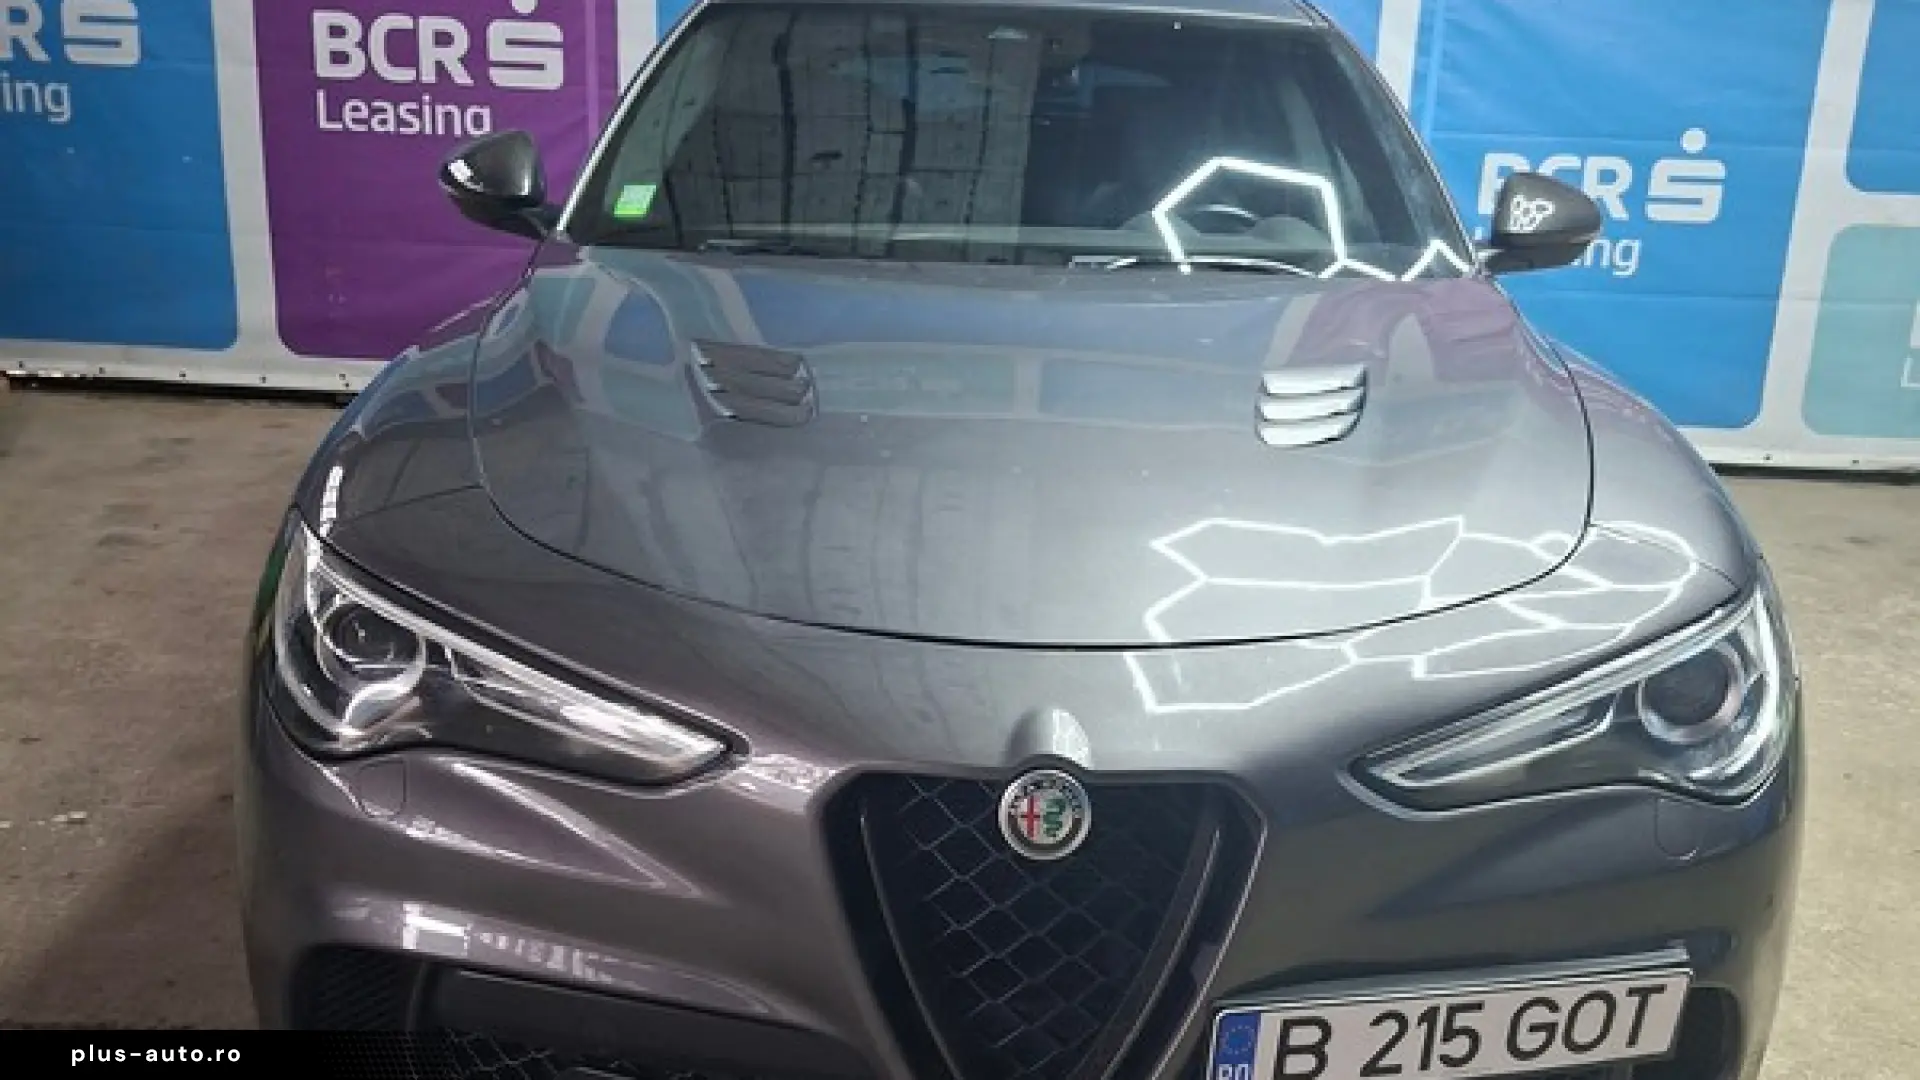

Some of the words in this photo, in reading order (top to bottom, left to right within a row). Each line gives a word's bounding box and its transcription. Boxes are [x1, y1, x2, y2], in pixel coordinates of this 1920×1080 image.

[312, 9, 475, 87] BCR
[316, 89, 492, 138] Leasing
[1273, 1015, 1332, 1080] B
[1360, 1002, 1485, 1078] 215
[1506, 984, 1667, 1062] GOT
